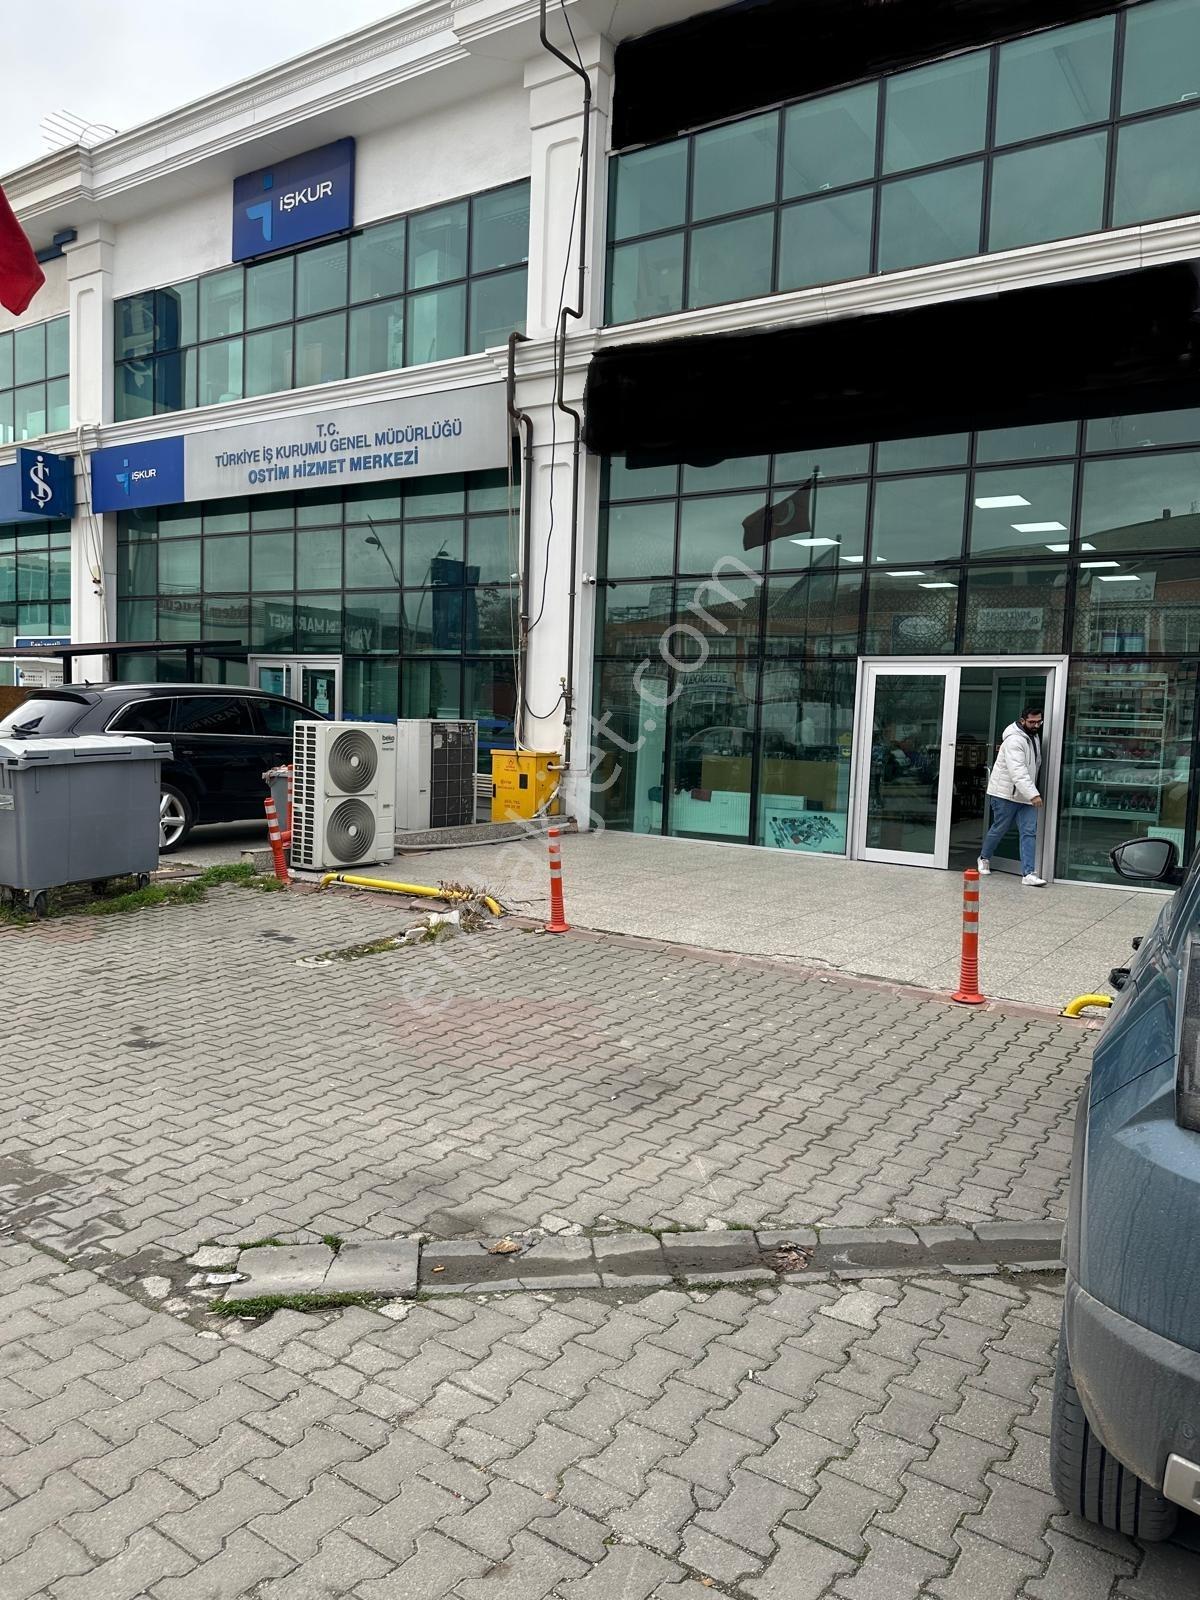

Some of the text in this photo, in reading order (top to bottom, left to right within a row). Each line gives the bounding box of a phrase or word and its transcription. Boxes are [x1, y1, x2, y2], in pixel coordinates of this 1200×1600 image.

[215, 418, 462, 468] TÜRKİYE İŞ KURUMU GENEL MÜDÜRLÜĞÜ
[316, 422, 339, 437] T.C.
[248, 446, 419, 484] OSTİM HİZMET MERKEZİ
